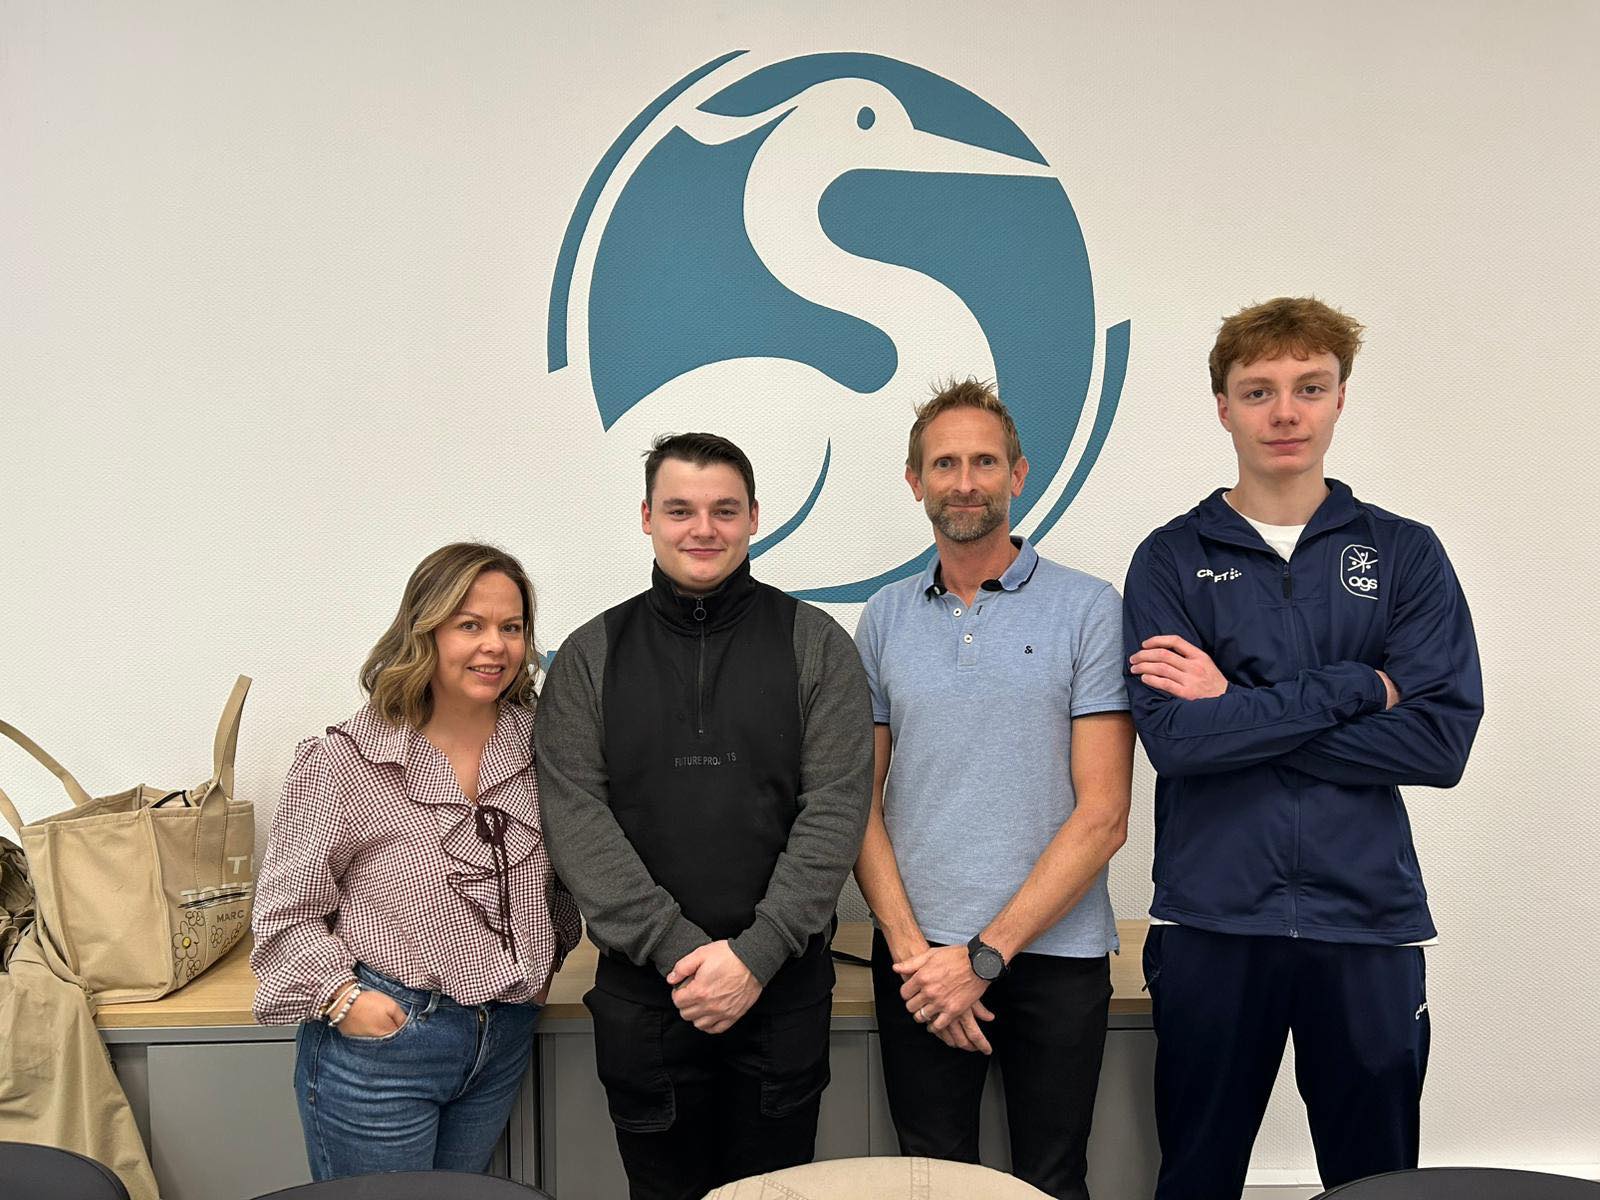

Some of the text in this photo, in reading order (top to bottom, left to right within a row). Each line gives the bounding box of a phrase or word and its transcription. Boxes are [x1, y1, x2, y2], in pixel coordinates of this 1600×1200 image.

[1196, 568, 1230, 583] CRFT
[1348, 576, 1378, 592] ags
[1024, 645, 1033, 655] &
[674, 752, 737, 768] FUTURE PROJTS
[216, 909, 245, 924] MARC
